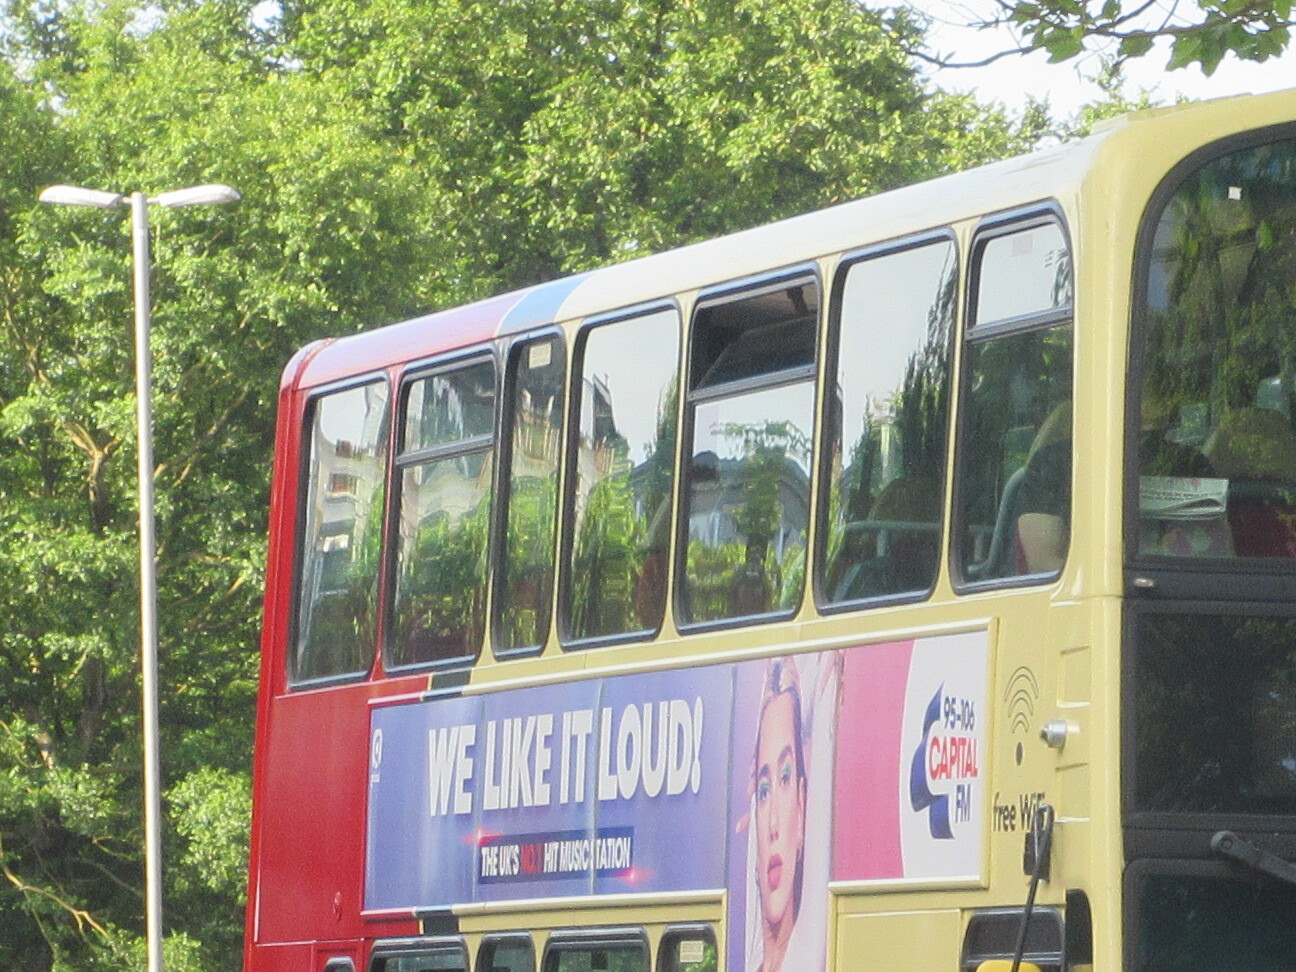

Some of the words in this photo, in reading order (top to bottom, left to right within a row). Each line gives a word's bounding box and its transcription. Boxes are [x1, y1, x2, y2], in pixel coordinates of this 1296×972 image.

[943, 696, 976, 732] 95-106
[428, 724, 477, 817] WE
[483, 713, 554, 811] LIKE
[559, 708, 595, 805] IT
[597, 695, 704, 801] LOUD!
[929, 736, 979, 780] CAPITAL
[955, 784, 972, 823] FM
[993, 791, 1016, 832] free
[481, 846, 498, 877] THE
[543, 841, 559, 873] HIT
[559, 839, 590, 872] MUSIC
